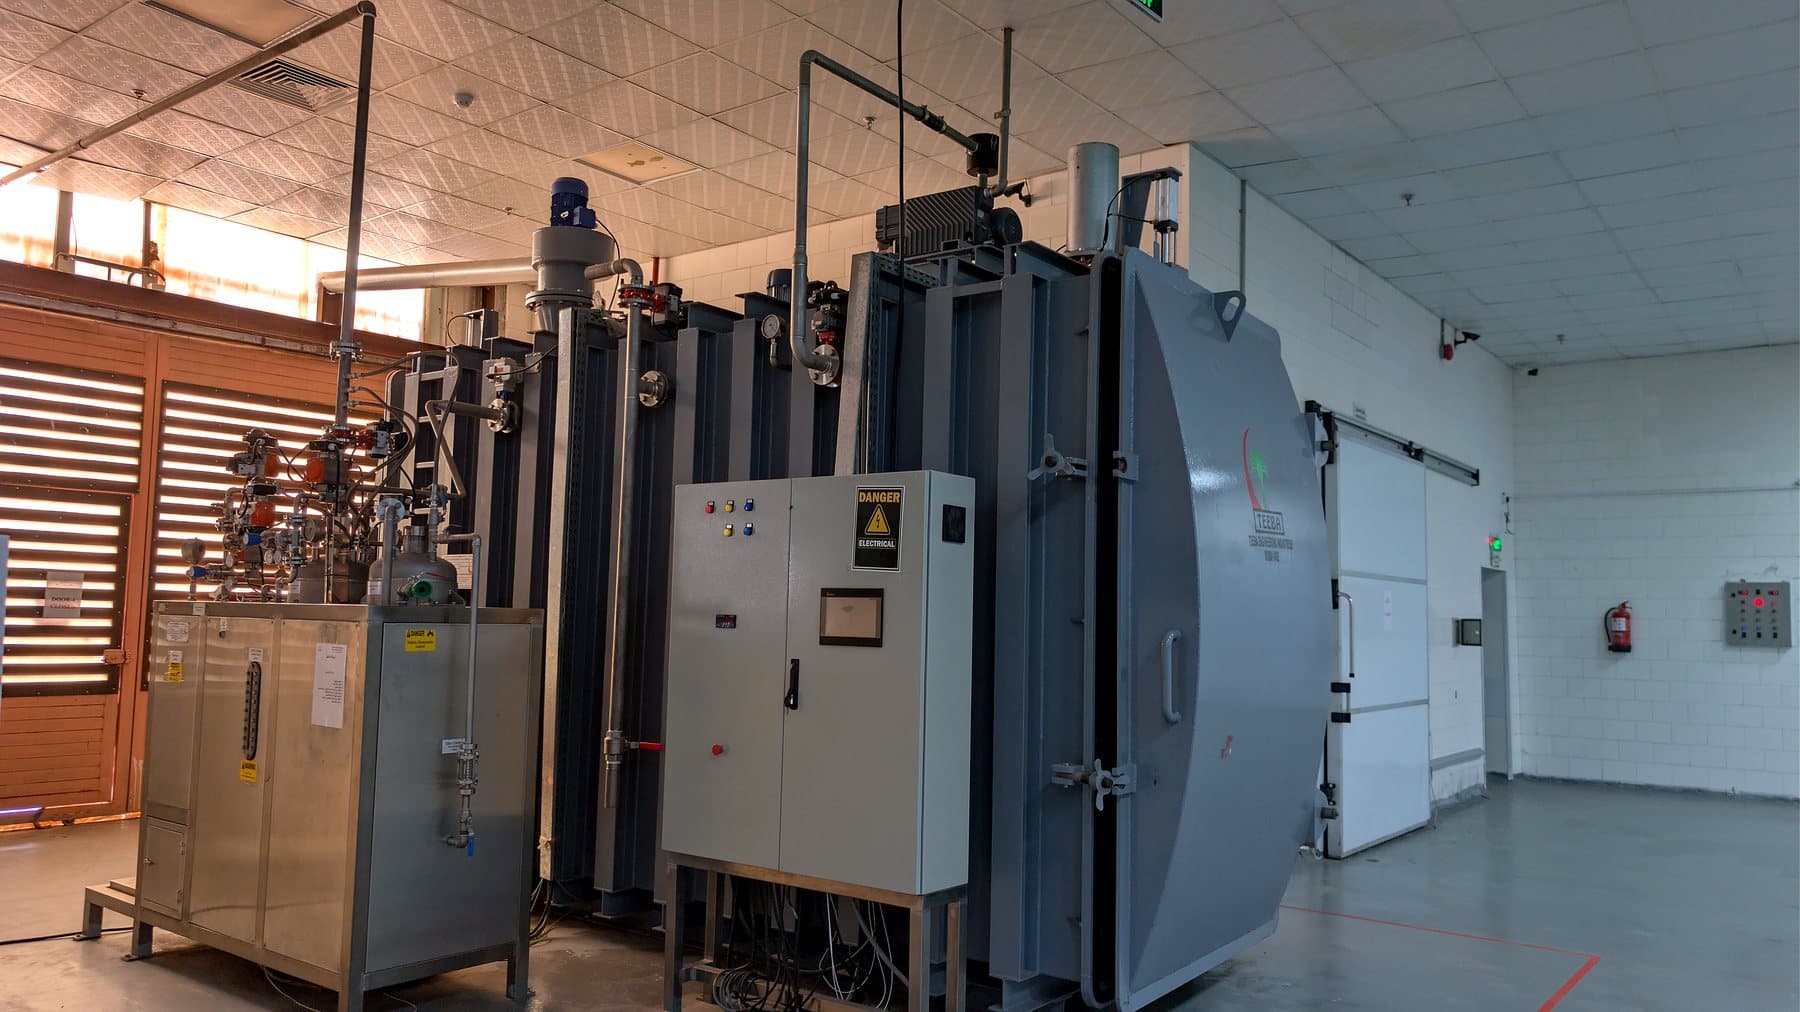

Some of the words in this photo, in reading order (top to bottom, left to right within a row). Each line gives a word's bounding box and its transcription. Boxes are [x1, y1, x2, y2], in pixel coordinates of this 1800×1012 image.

[859, 492, 901, 503] DANGER
[1257, 514, 1281, 530] TEEBA
[858, 539, 896, 548] ELECTRICAL
